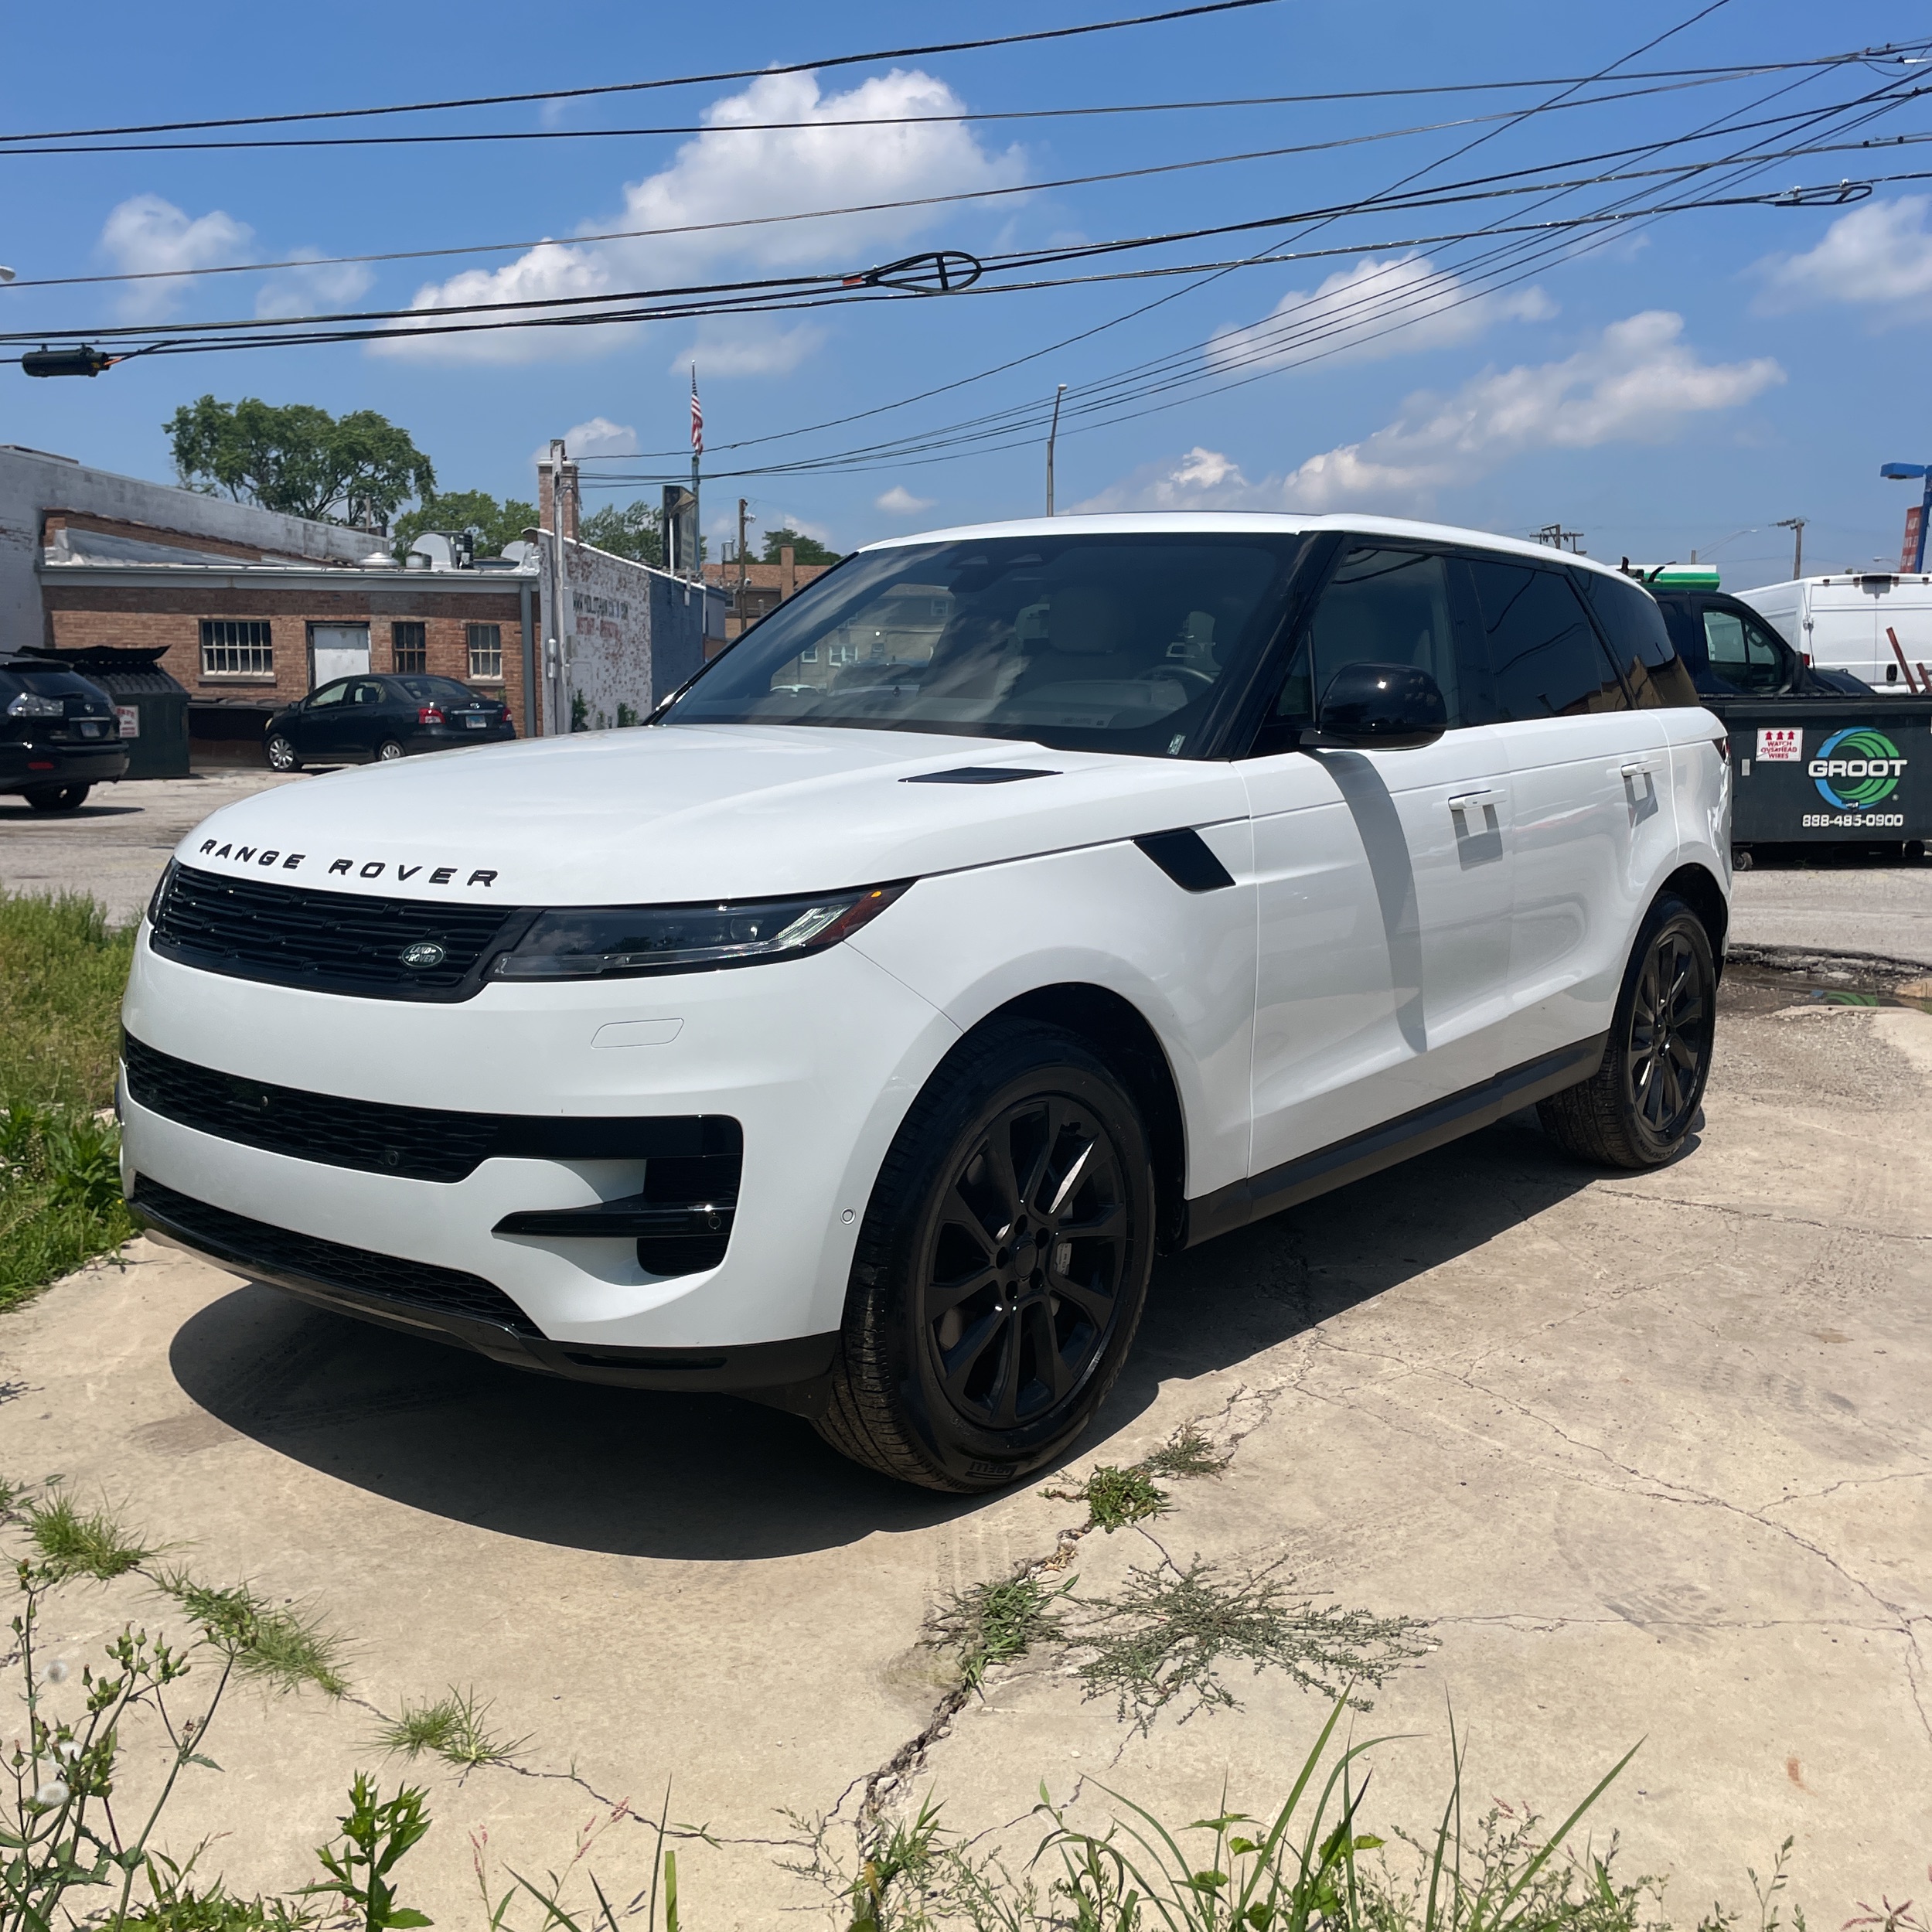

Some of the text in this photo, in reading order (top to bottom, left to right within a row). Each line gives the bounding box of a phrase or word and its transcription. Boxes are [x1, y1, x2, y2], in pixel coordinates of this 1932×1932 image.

[1808, 759, 1907, 777] GROOT
[1802, 814, 1903, 827] 888-485-0900
[199, 838, 498, 888] RANGE ROVER
[409, 946, 432, 954] LAND
[408, 954, 435, 963] ROVER
